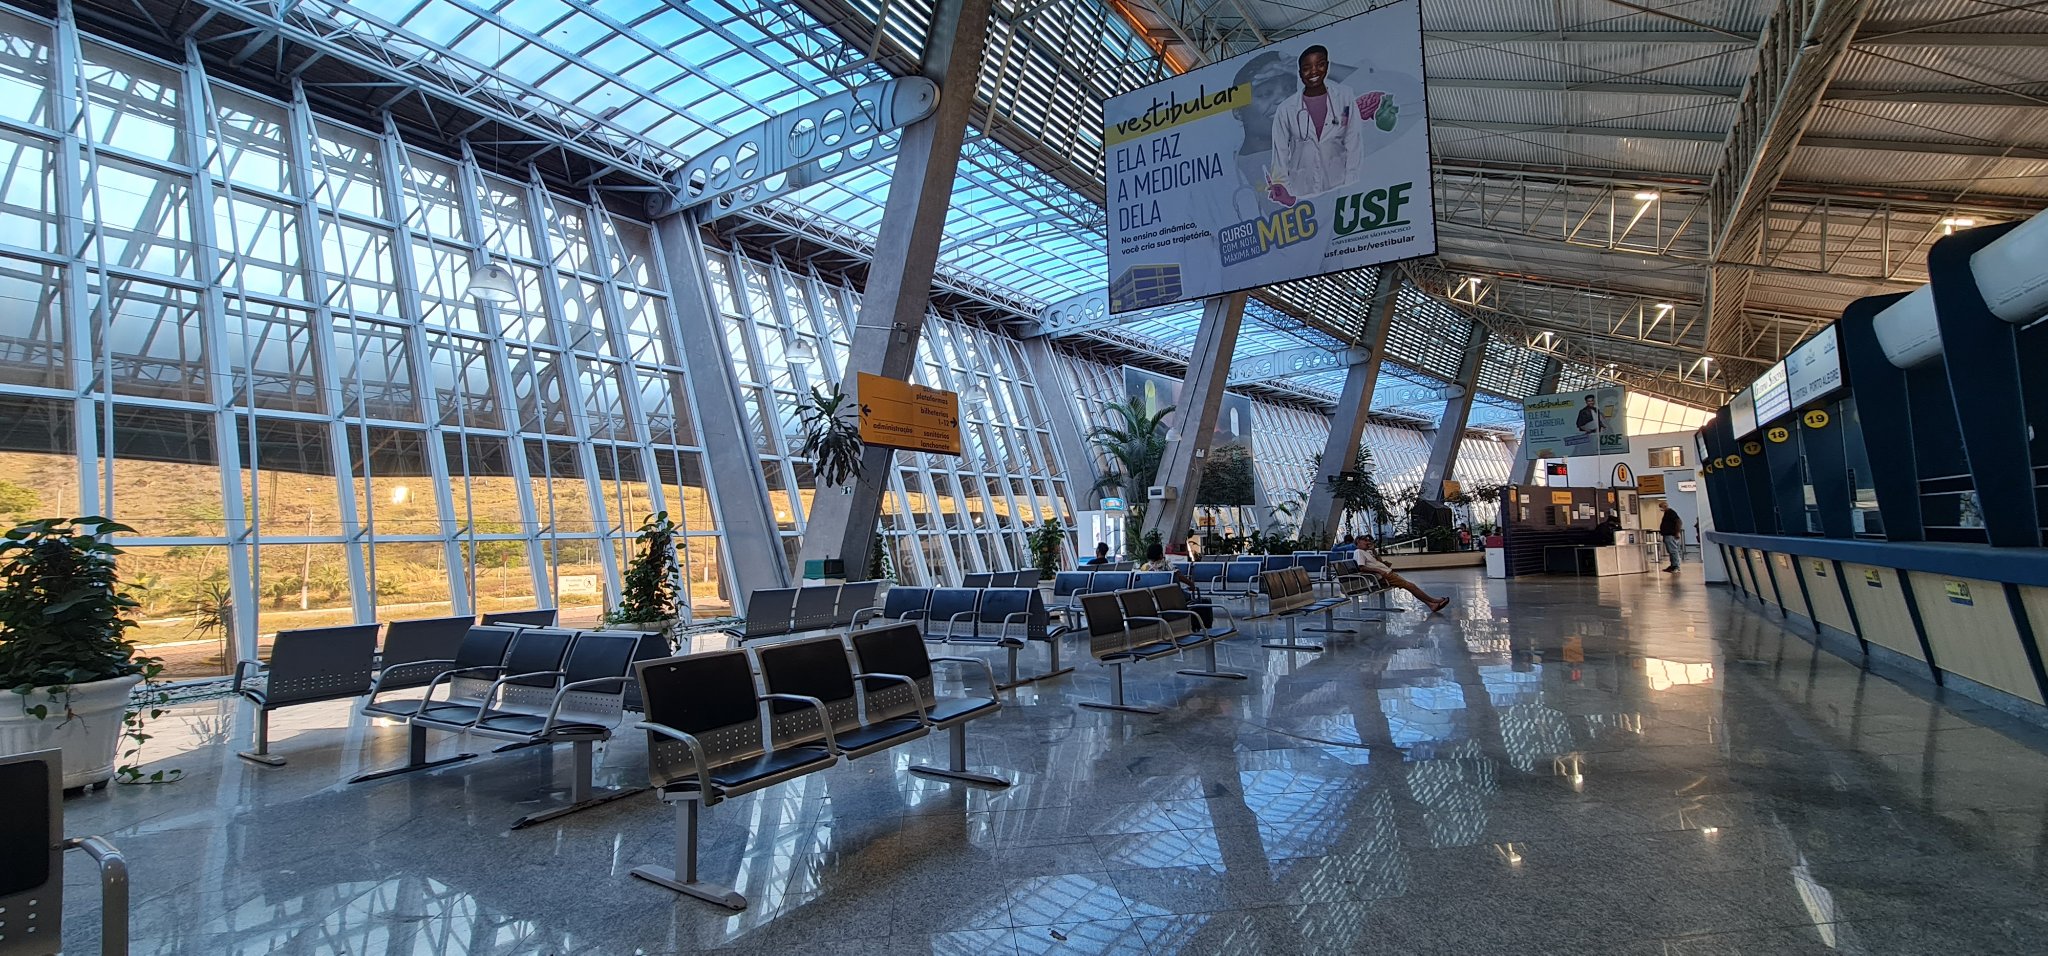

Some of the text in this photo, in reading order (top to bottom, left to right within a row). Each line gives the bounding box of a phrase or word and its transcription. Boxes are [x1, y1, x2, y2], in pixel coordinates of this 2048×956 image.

[1116, 84, 1239, 136] vestibular
[1117, 132, 1182, 174] ELA FAZ
[1117, 153, 1223, 203] A MEDICINA
[1119, 200, 1161, 232] DELA
[1333, 182, 1413, 236] USF
[1121, 222, 1198, 245] No ensino dinâmico,
[1221, 203, 1315, 252] CURSO MEC
[1332, 234, 1369, 246] UNIVERSIDADE
[1381, 226, 1412, 236] FRANCISCO
[1121, 229, 1212, 255] você cria sua trajetória.
[1222, 235, 1258, 254] COM NOTA
[1250, 245, 1261, 256] NO
[1323, 235, 1416, 258] usf.edu.br/vestibular
[916, 392, 949, 405] plataformas
[1527, 398, 1571, 409] vestibular
[920, 406, 949, 418] bilheterias
[1807, 414, 1825, 424] 19
[1600, 433, 1623, 446] USF
[1770, 431, 1786, 439] 18
[1746, 444, 1759, 452] 17
[1727, 457, 1739, 465] 16
